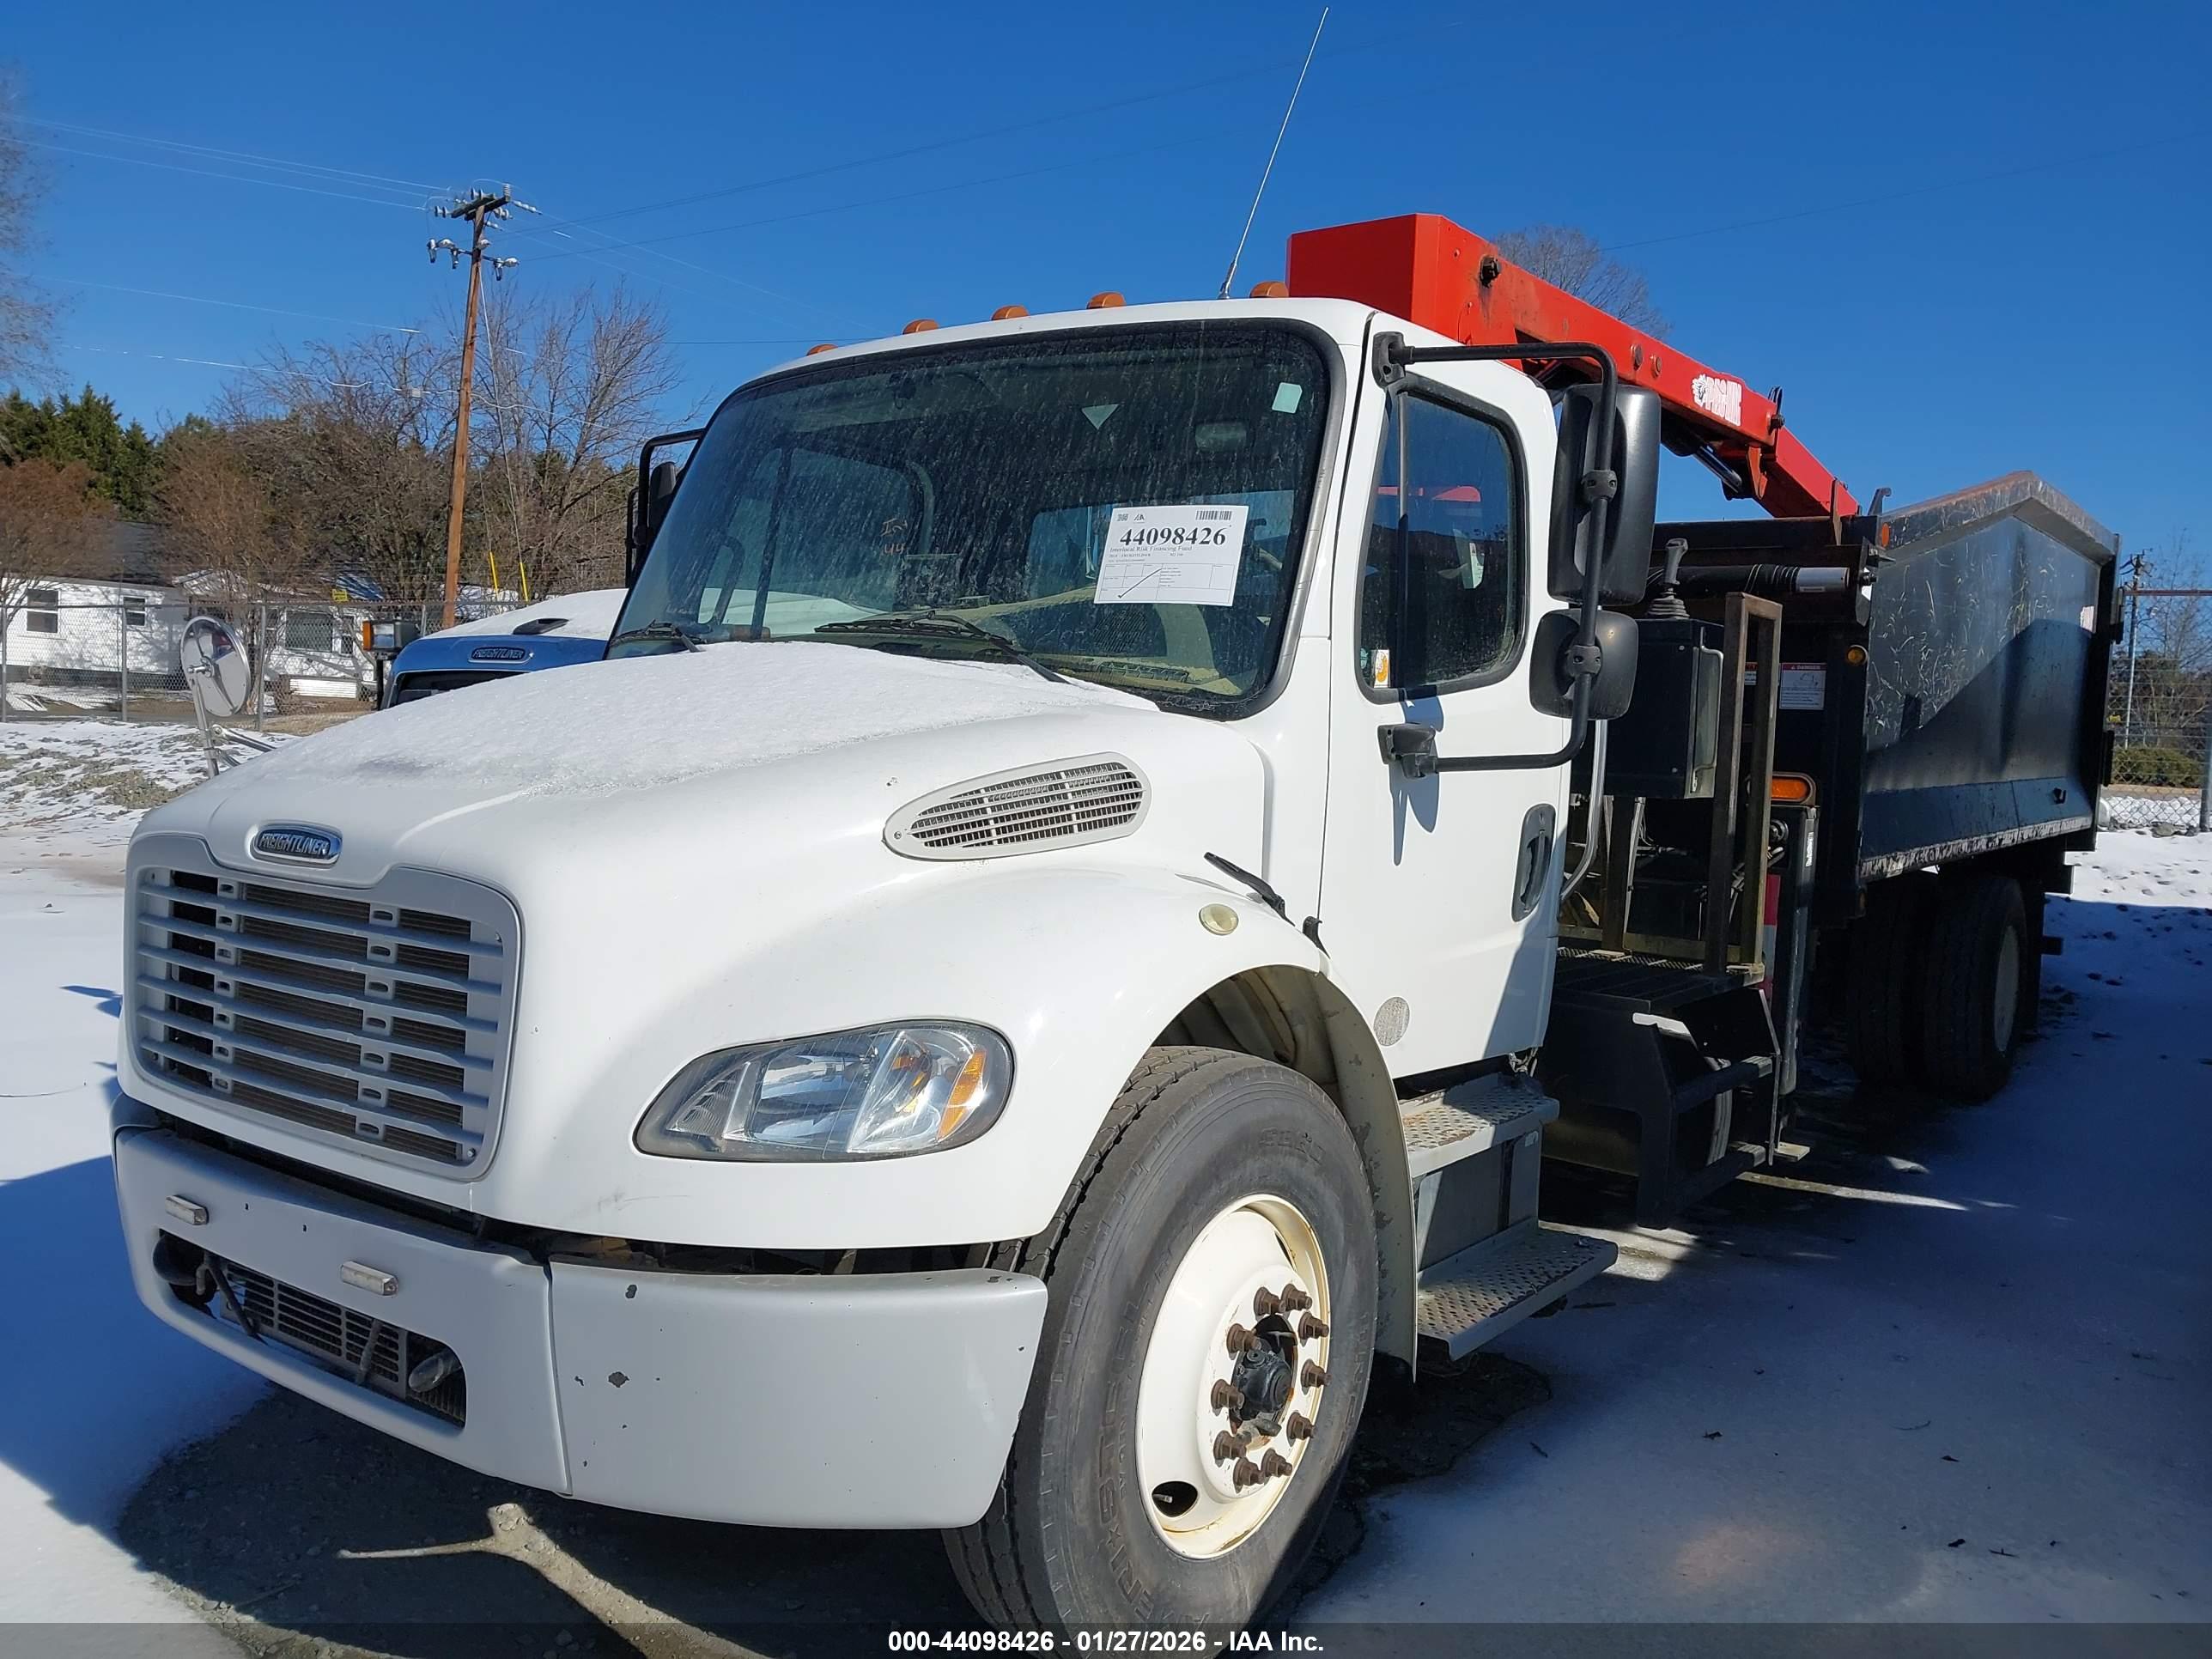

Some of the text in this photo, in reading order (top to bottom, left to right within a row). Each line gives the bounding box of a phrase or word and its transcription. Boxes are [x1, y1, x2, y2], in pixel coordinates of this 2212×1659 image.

[1120, 527, 1227, 545] 44098426
[472, 647, 524, 659] FREIGHTLINER
[258, 832, 330, 855] FREIGHTLINER
